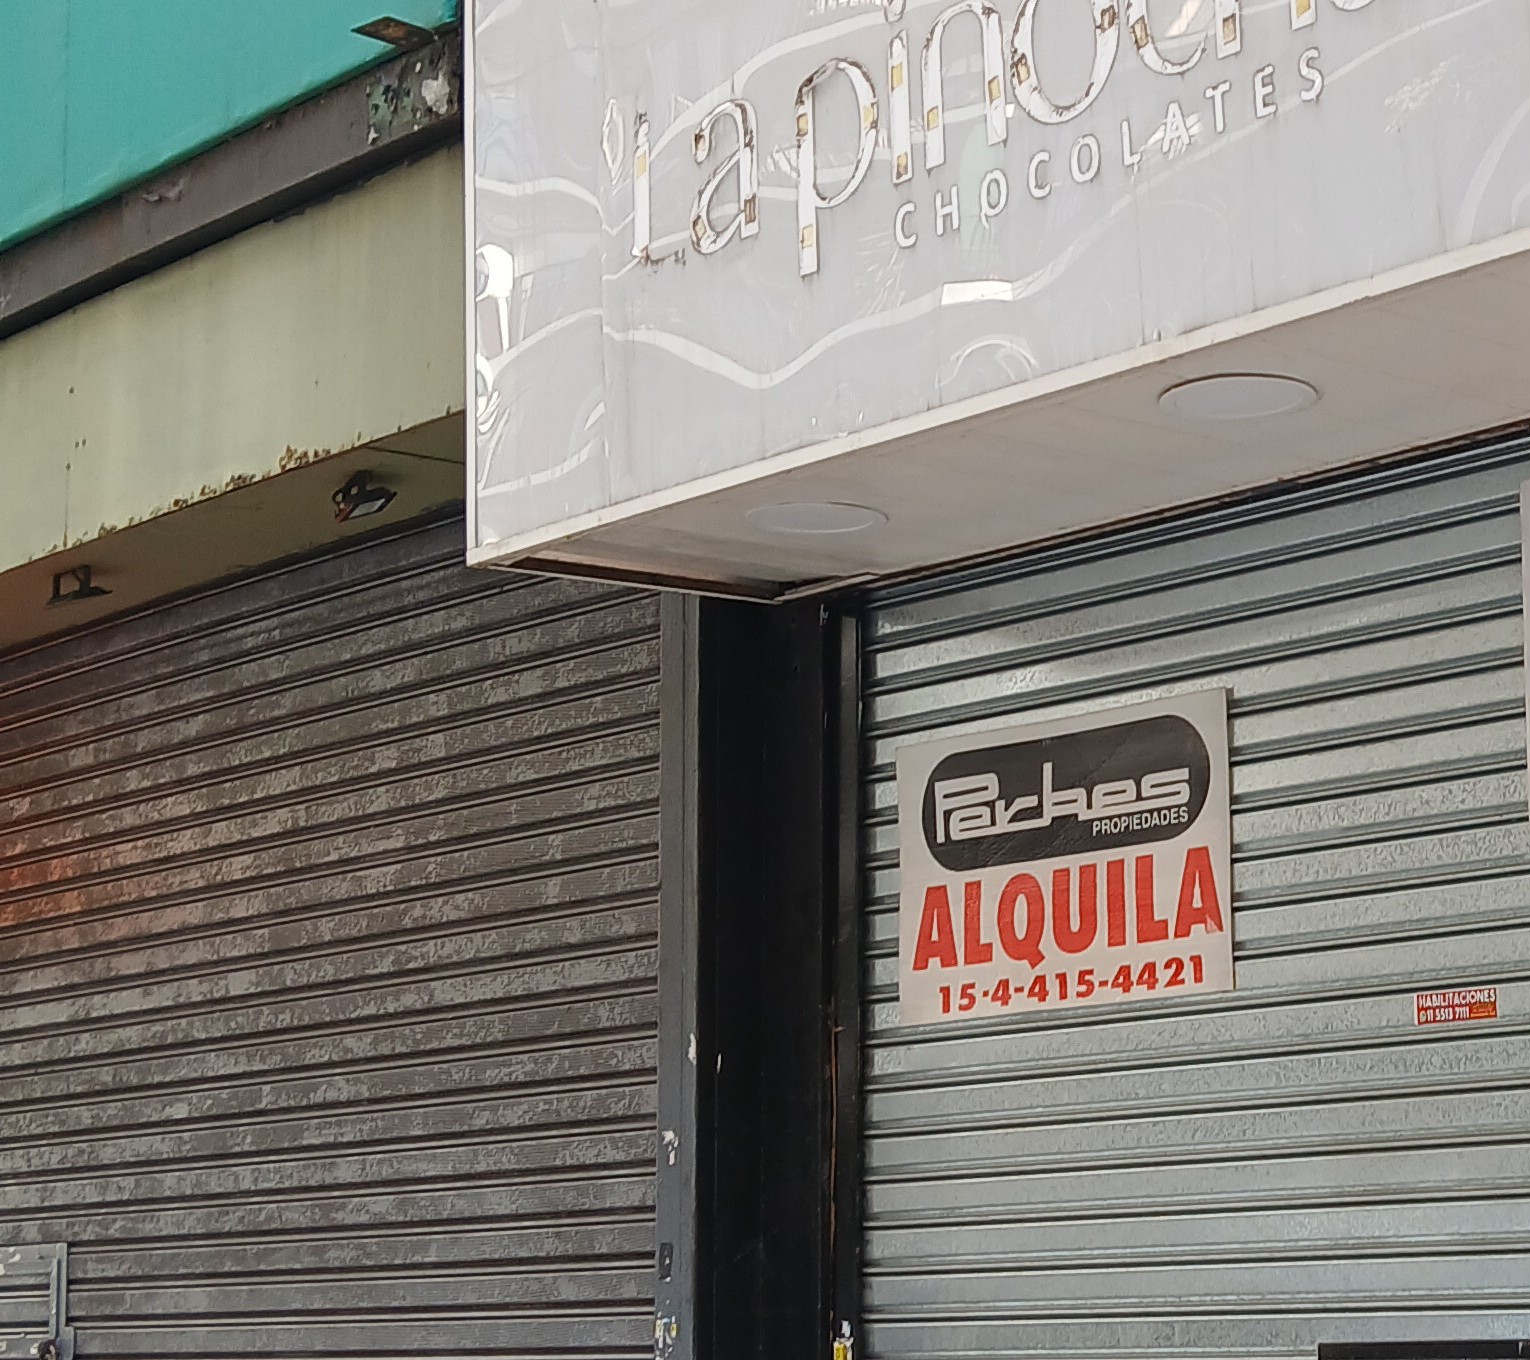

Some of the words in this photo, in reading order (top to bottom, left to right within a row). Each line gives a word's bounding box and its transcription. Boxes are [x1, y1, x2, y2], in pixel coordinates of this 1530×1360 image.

[893, 47, 1326, 248] CHOCOLATES
[1092, 806, 1189, 837] PROPIEDADES
[912, 845, 1224, 971] ALQUILA
[1418, 988, 1496, 1008] HABILITACIONES
